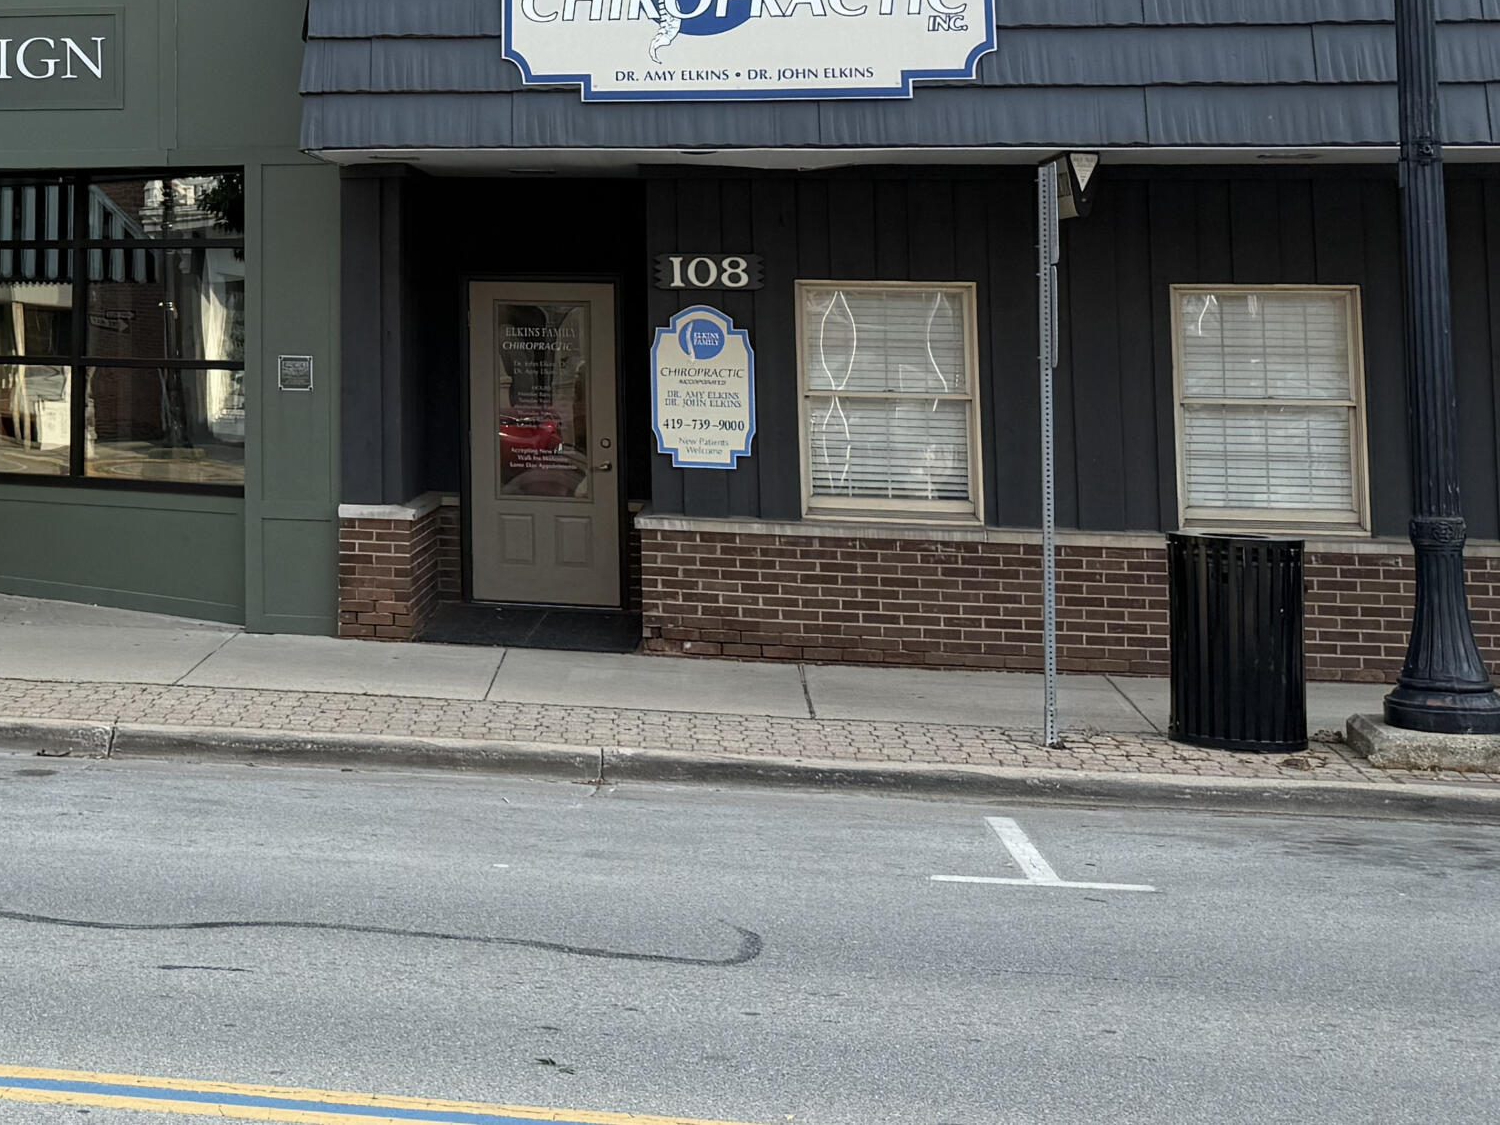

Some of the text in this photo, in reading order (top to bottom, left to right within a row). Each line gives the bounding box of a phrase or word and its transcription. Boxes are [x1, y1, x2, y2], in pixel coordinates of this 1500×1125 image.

[926, 13, 969, 33] INC.
[614, 67, 875, 83] DR. AMY ELKINS DR. JOHN ELKINS
[668, 256, 749, 288] 108
[505, 327, 576, 338] ELKINS FAMILY
[502, 341, 573, 352] CHIROPRACTIC
[659, 367, 745, 378] CHIROPRACTIC
[707, 391, 740, 400] ELKINS
[709, 399, 742, 408] ELKINS
